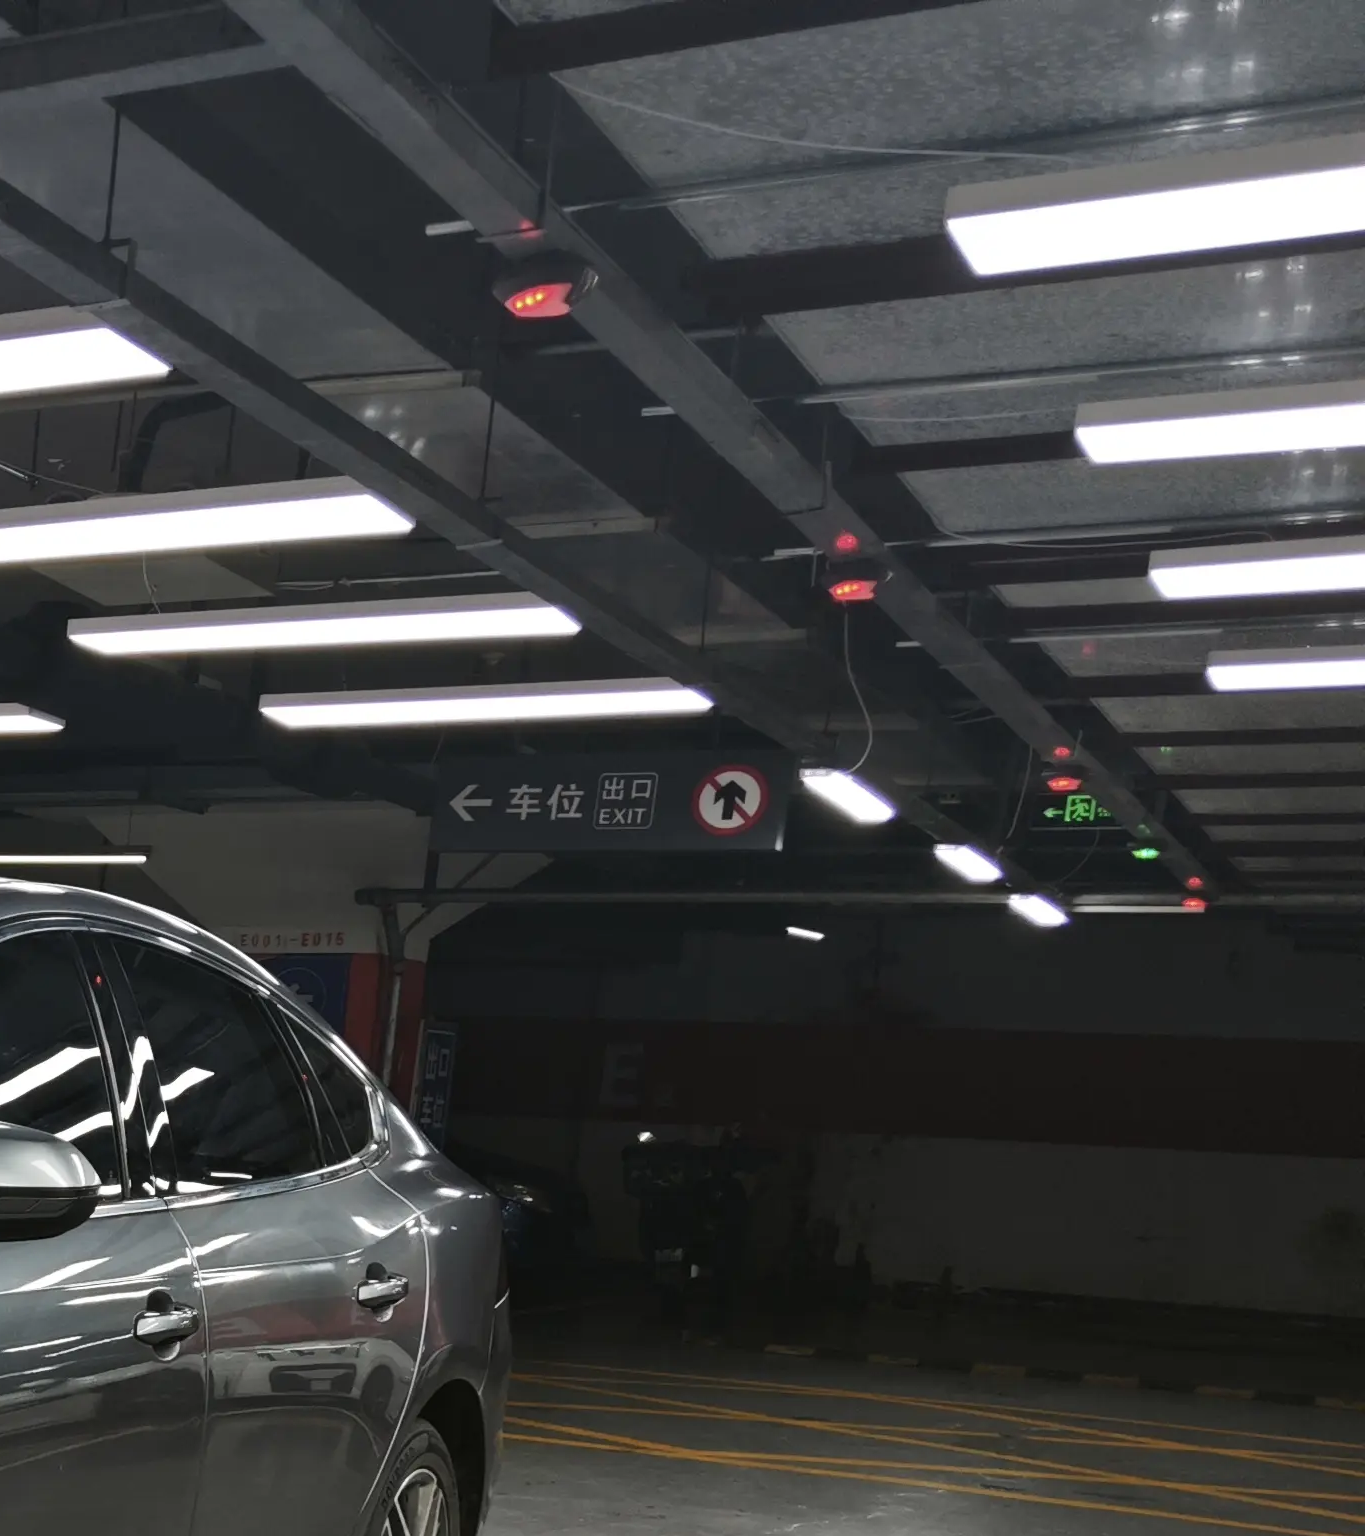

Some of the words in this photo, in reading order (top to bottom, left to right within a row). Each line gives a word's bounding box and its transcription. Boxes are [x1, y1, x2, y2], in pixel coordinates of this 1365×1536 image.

[601, 776, 653, 801] 出口
[505, 783, 586, 821] 车位
[598, 807, 645, 825] EXIT
